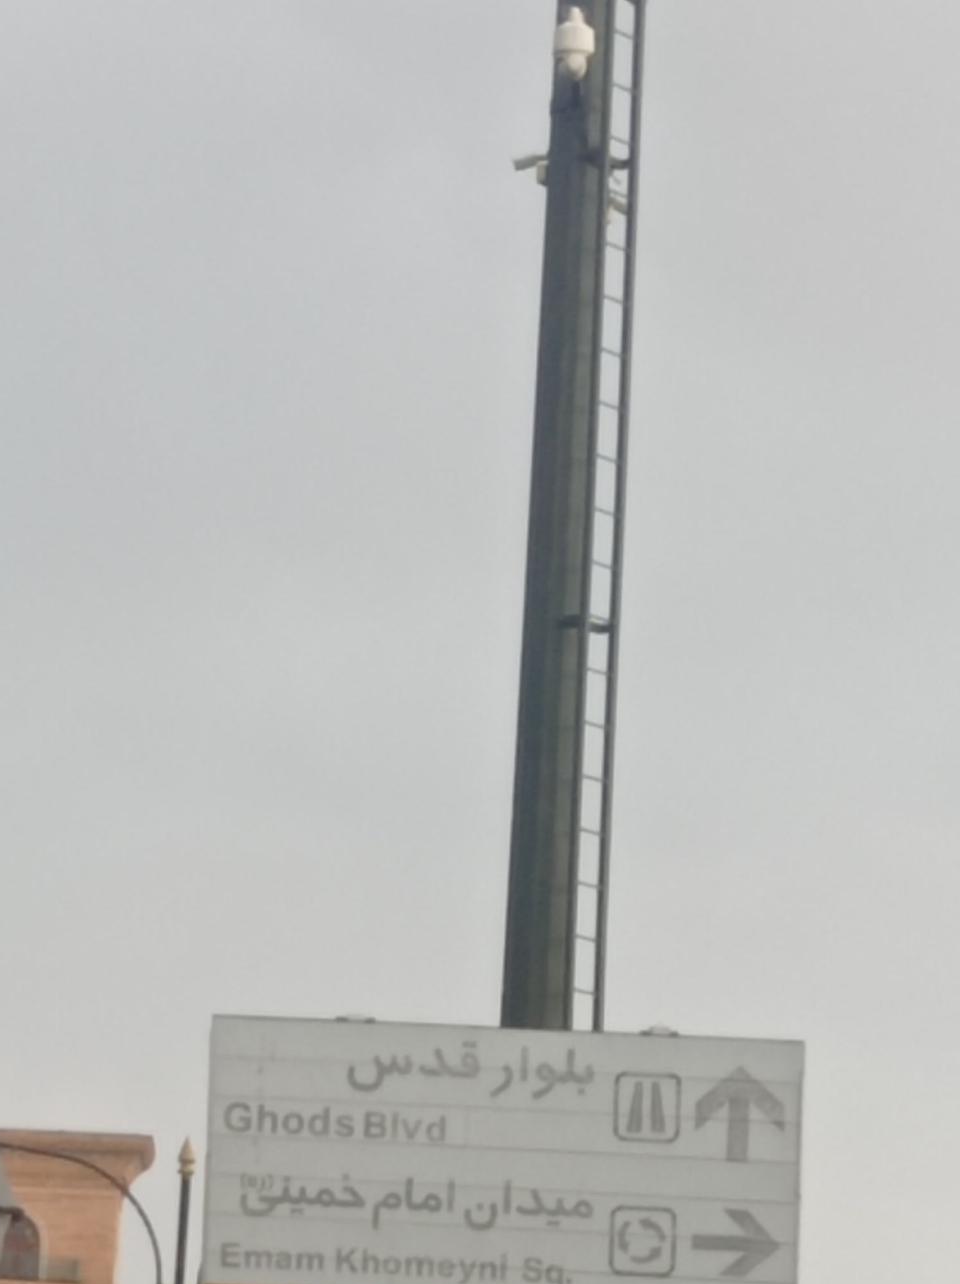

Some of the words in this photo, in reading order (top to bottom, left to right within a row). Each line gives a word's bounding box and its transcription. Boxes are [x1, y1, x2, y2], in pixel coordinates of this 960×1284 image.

[346, 1040, 481, 1093] قدس
[490, 1044, 596, 1099] بلوار
[222, 1101, 355, 1139] Ghods
[363, 1111, 448, 1145] Blvd
[239, 1173, 366, 1217] خمینی
[371, 1176, 456, 1231] امام
[463, 1179, 594, 1231] میدان
[220, 1242, 326, 1272] Emam
